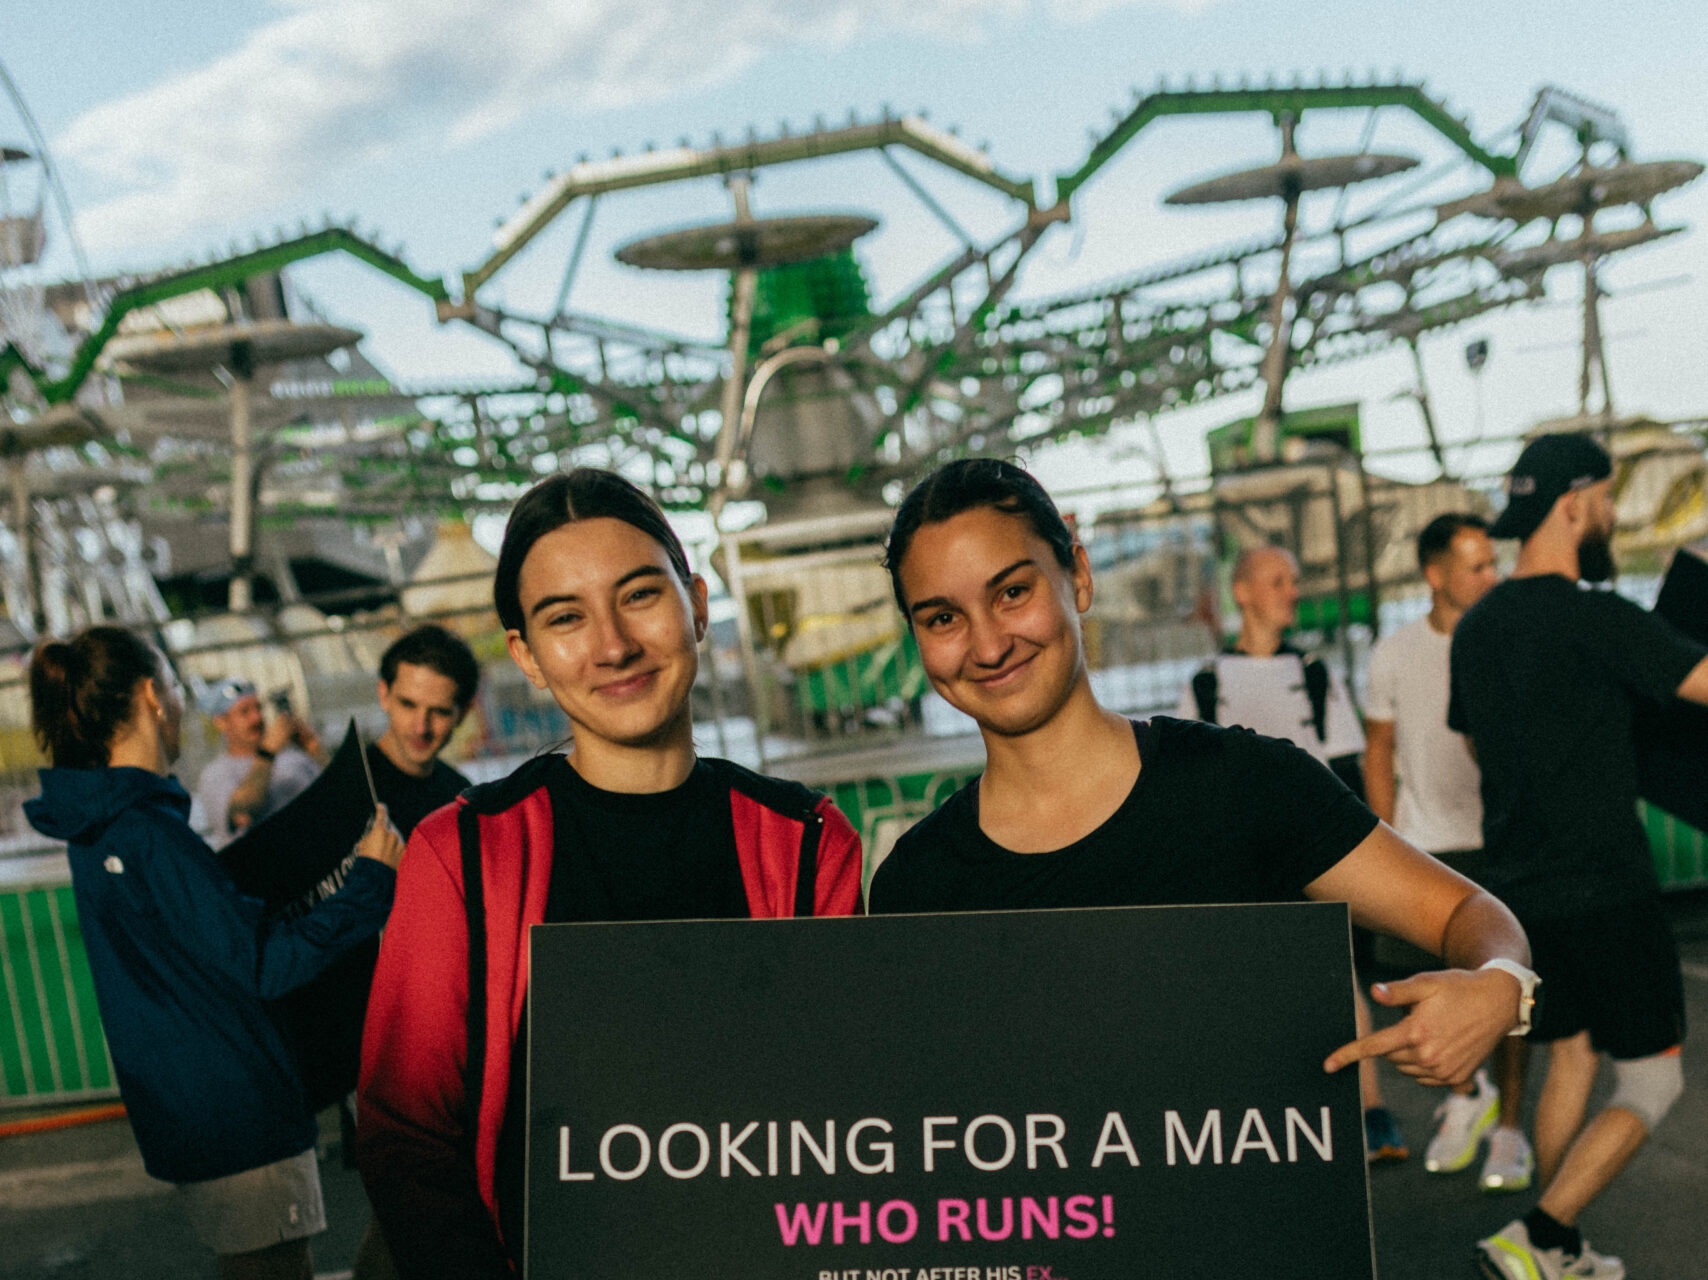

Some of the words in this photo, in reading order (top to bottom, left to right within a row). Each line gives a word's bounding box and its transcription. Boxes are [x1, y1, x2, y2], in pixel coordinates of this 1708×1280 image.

[558, 1117, 896, 1182] LOOKING
[922, 1113, 1070, 1173] FOR
[1090, 1110, 1141, 1169] A
[1163, 1105, 1334, 1167] MAN
[774, 1199, 920, 1247] WHO
[936, 1193, 1116, 1243] RUNS!
